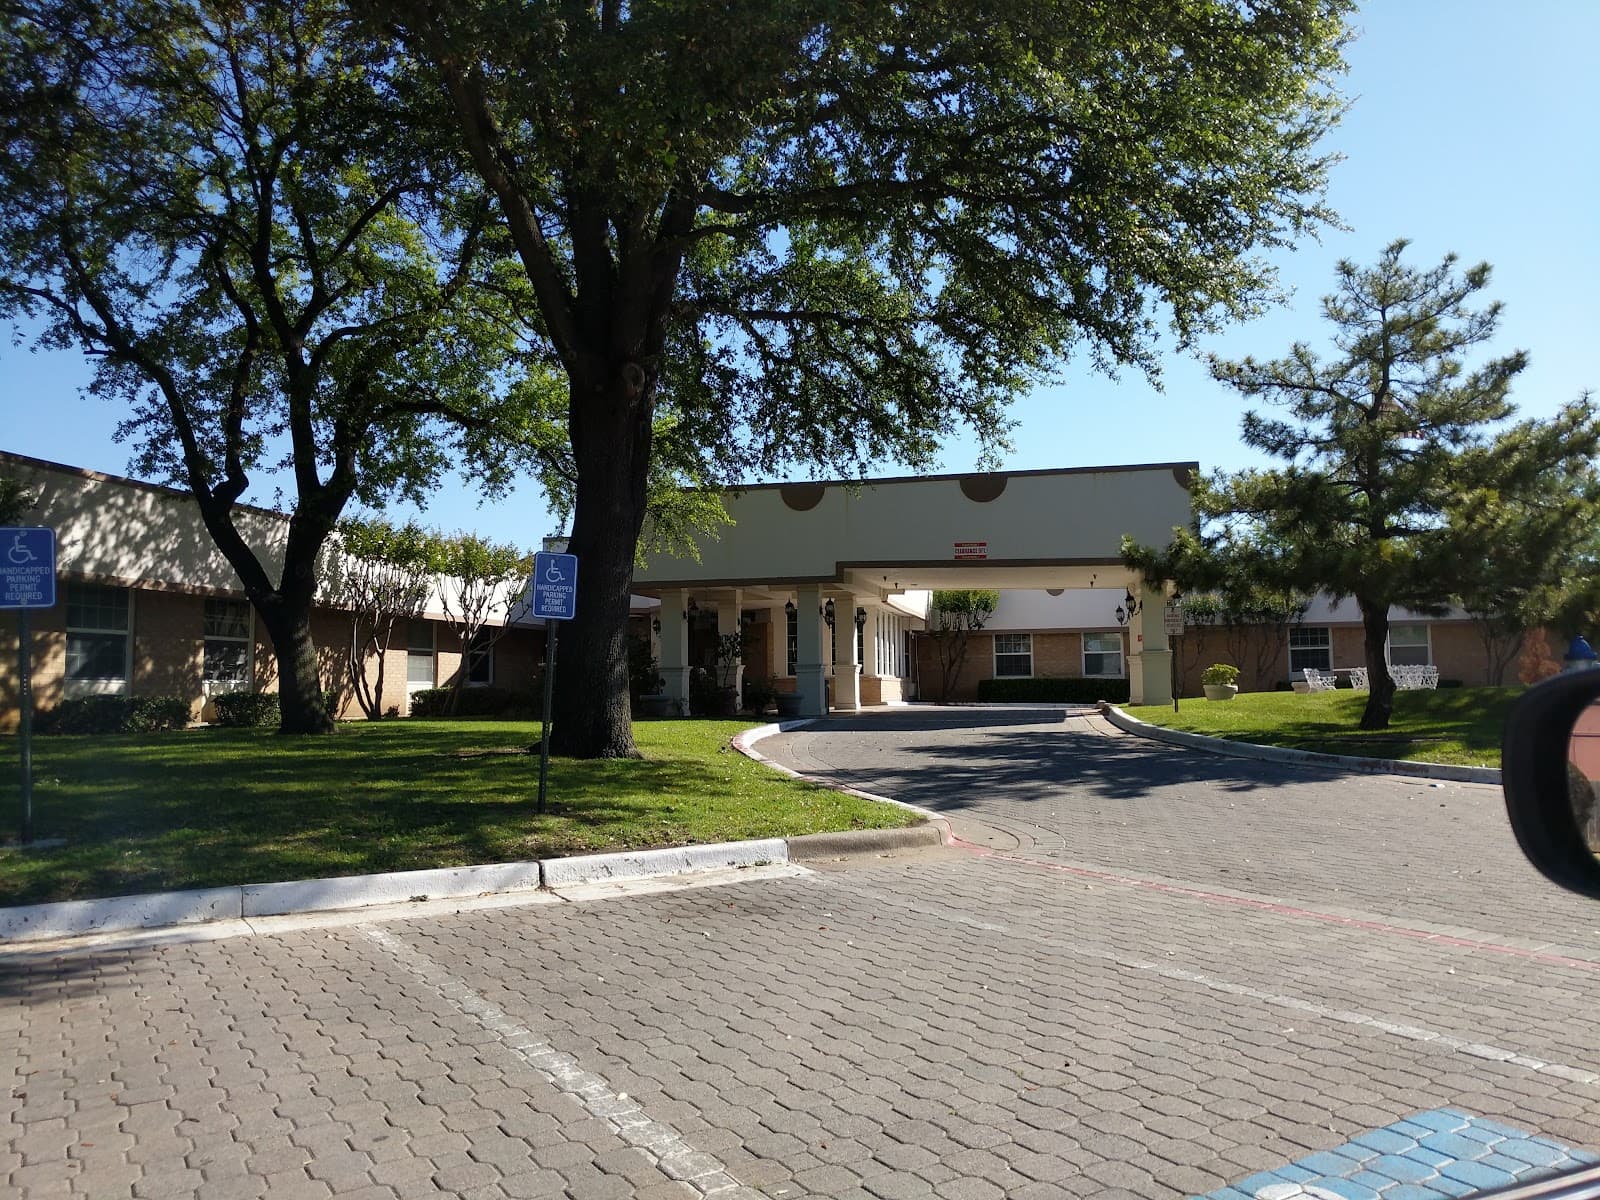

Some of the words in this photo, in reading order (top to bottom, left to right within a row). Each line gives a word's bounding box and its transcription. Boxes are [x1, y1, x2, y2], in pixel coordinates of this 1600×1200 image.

[10, 584, 37, 592] PERMIT
[536, 583, 573, 592] HANDICAPPED
[5, 592, 43, 600] REQUIRED
[542, 591, 567, 599] PARKING
[544, 598, 563, 606] PERMIT
